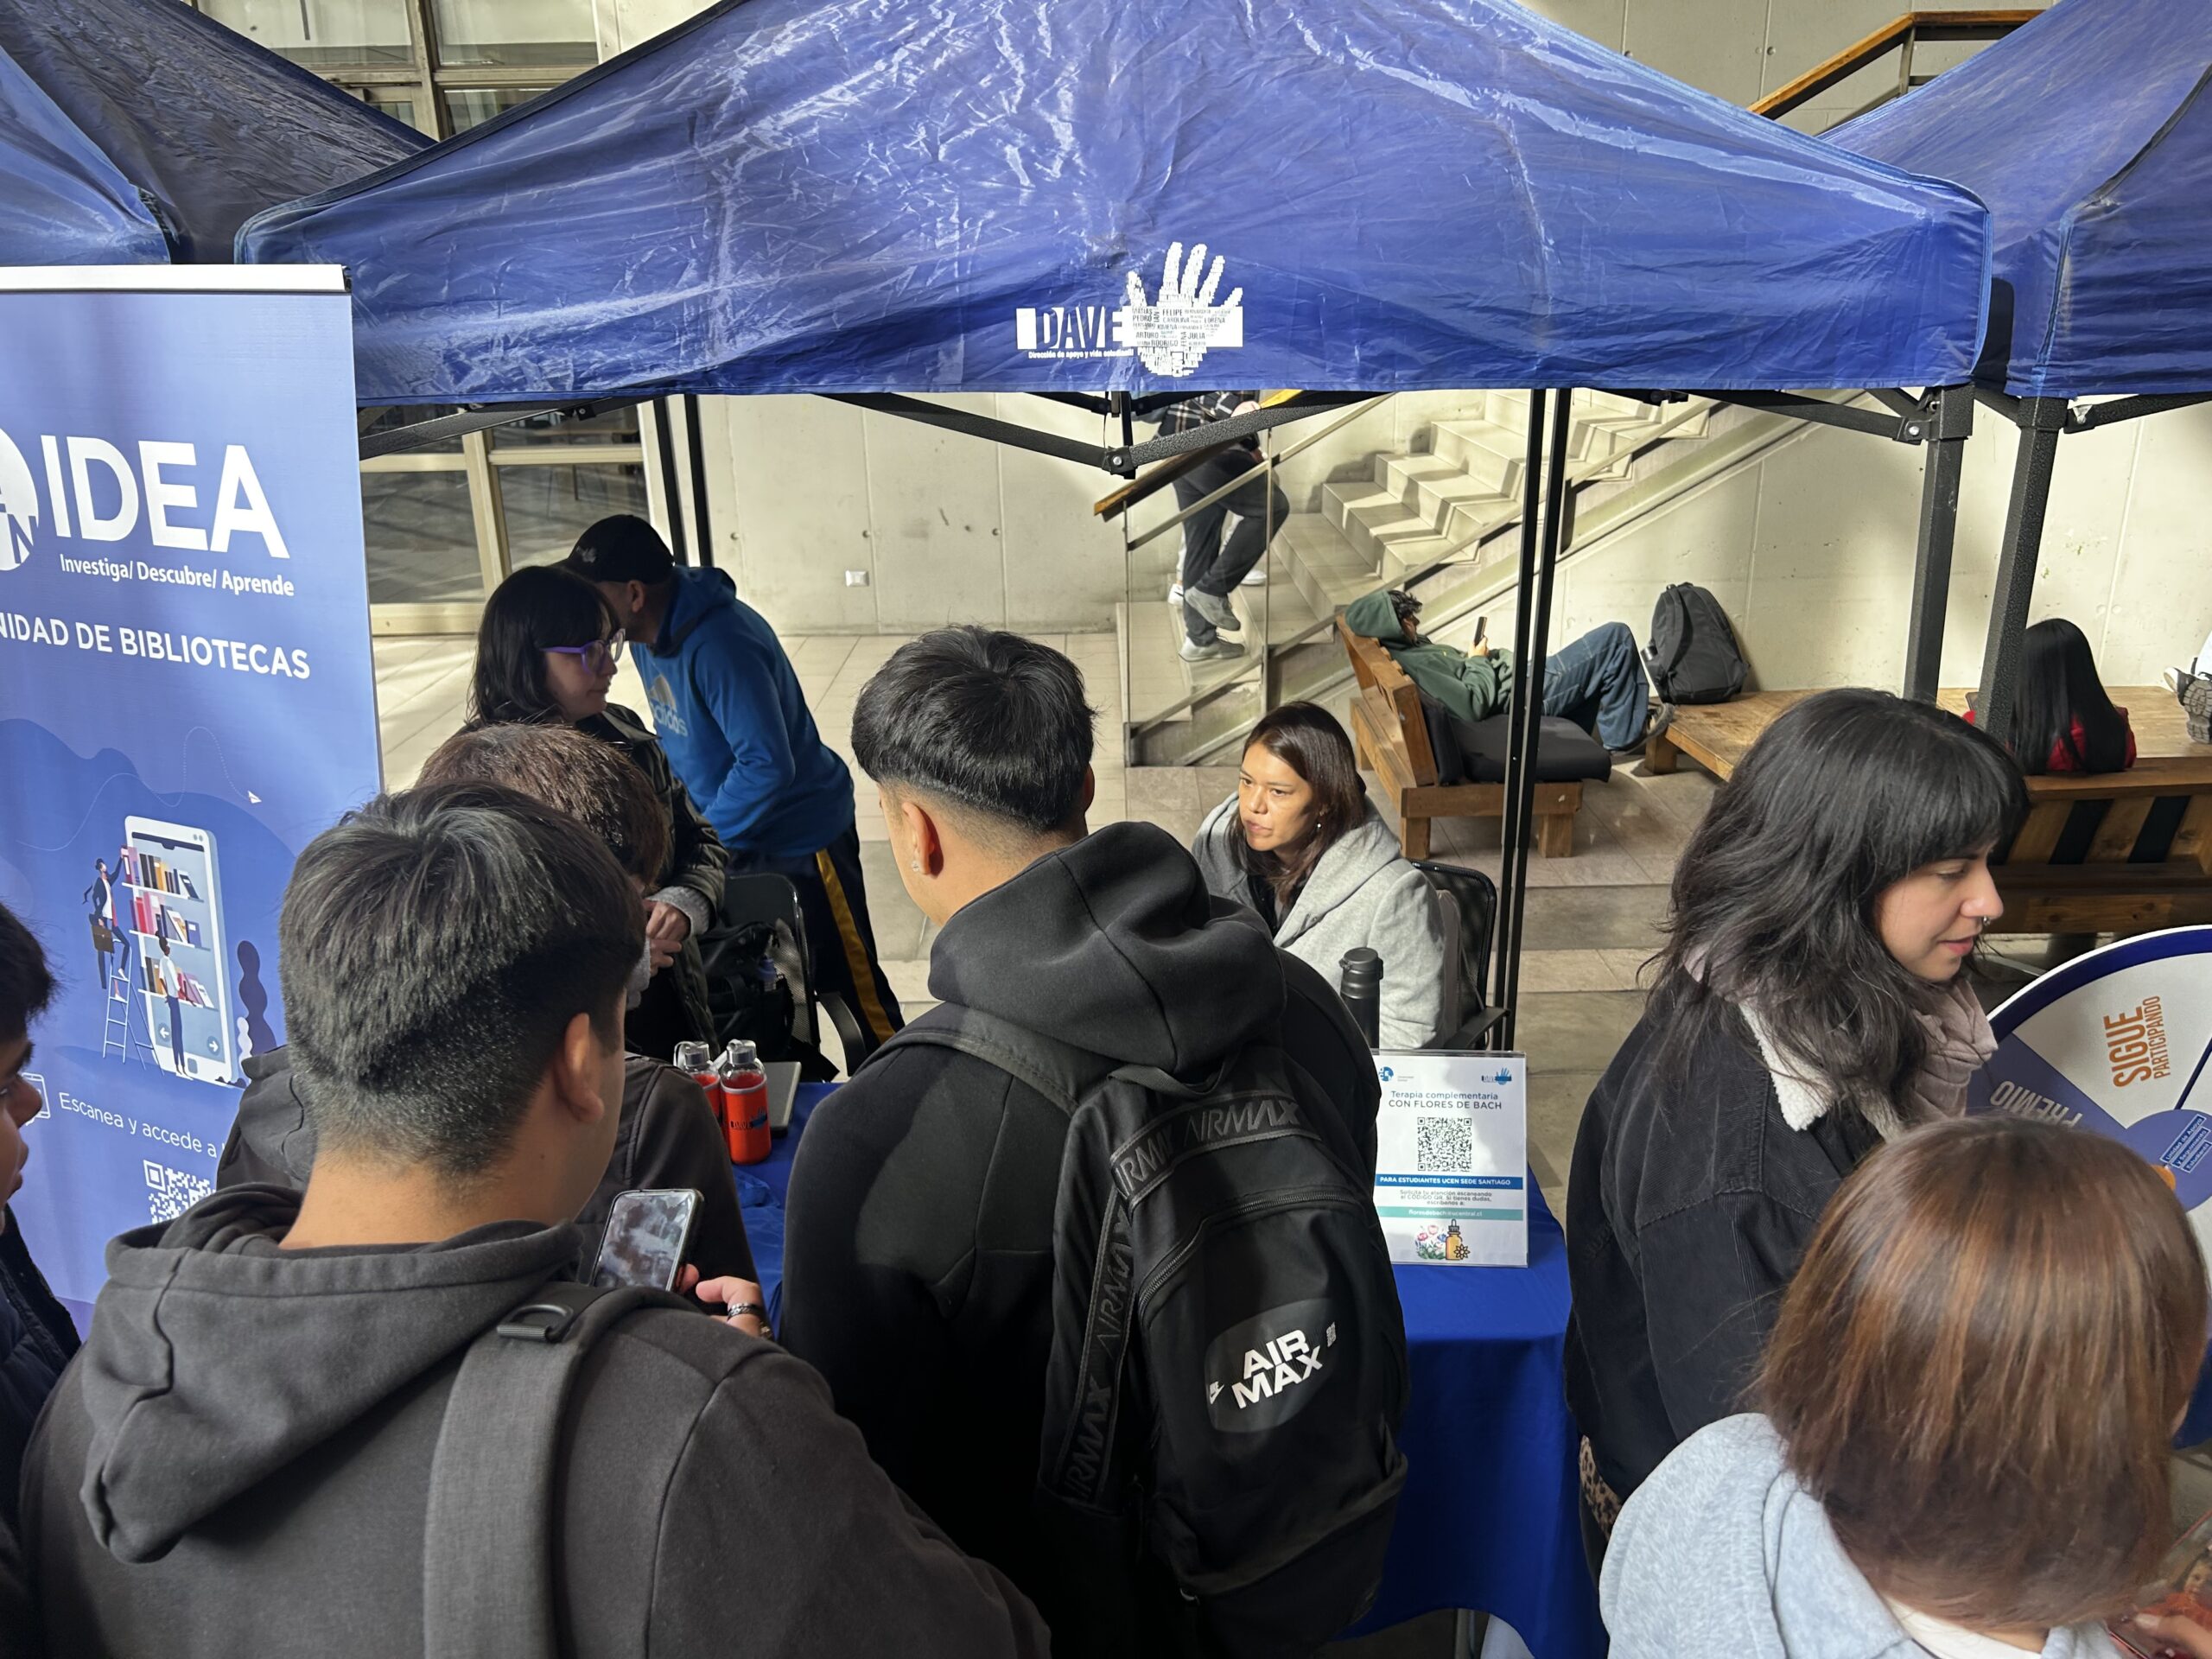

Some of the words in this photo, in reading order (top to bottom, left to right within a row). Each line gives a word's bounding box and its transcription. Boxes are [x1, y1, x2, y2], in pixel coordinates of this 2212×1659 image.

[1027, 349, 1056, 359] Dirección
[1057, 349, 1065, 358] de
[1042, 306, 1122, 349] DAVE
[41, 435, 290, 559] IDEA
[60, 553, 134, 582] Investiga/
[137, 562, 217, 588] Descubre/
[221, 570, 295, 596] Aprende
[0, 612, 69, 646] IDAD
[75, 622, 112, 652] DE
[118, 627, 310, 680] BIBLIOTECAS
[2103, 1006, 2152, 1088] SIGUE
[2142, 995, 2171, 1080] PARTICIPANDO
[59, 1091, 124, 1129] Escanea
[128, 1118, 137, 1135] y
[142, 1122, 203, 1154] accede
[1391, 1090, 1423, 1099] Terapia
[1425, 1091, 1498, 1101] complementaria
[1414, 1100, 1453, 1109] FLORES
[1231, 1345, 1324, 1409] MAX
[1243, 1329, 1311, 1380] AIR
